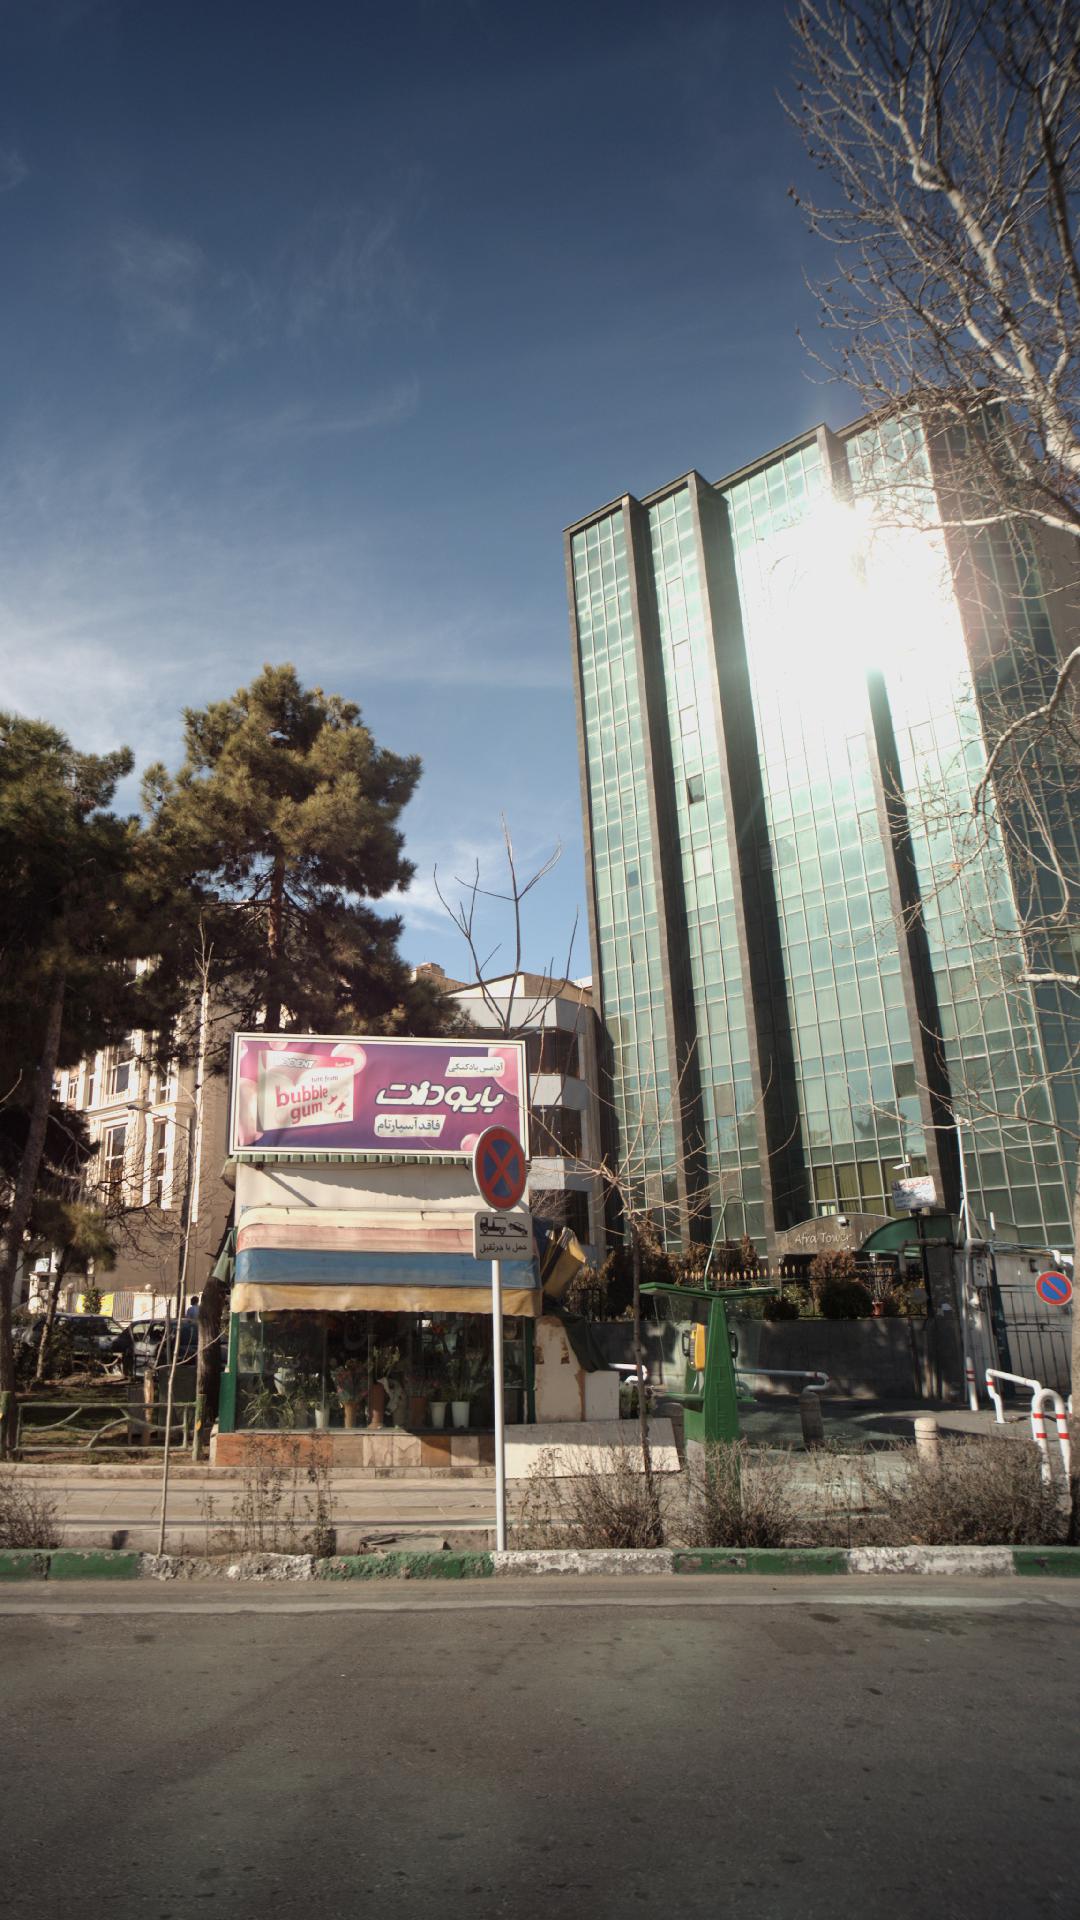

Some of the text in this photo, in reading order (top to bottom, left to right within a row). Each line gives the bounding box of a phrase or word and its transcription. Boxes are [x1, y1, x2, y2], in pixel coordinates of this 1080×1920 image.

[480, 1061, 503, 1073] آدامس
[275, 1085, 329, 1107] bubble
[375, 1080, 504, 1113] بایودنت
[291, 1101, 323, 1124] gum
[377, 1116, 441, 1133] فاقد آسپارتام
[795, 1232, 817, 1245] Afra
[820, 1231, 852, 1243] Tower
[512, 1242, 527, 1253] حمل
